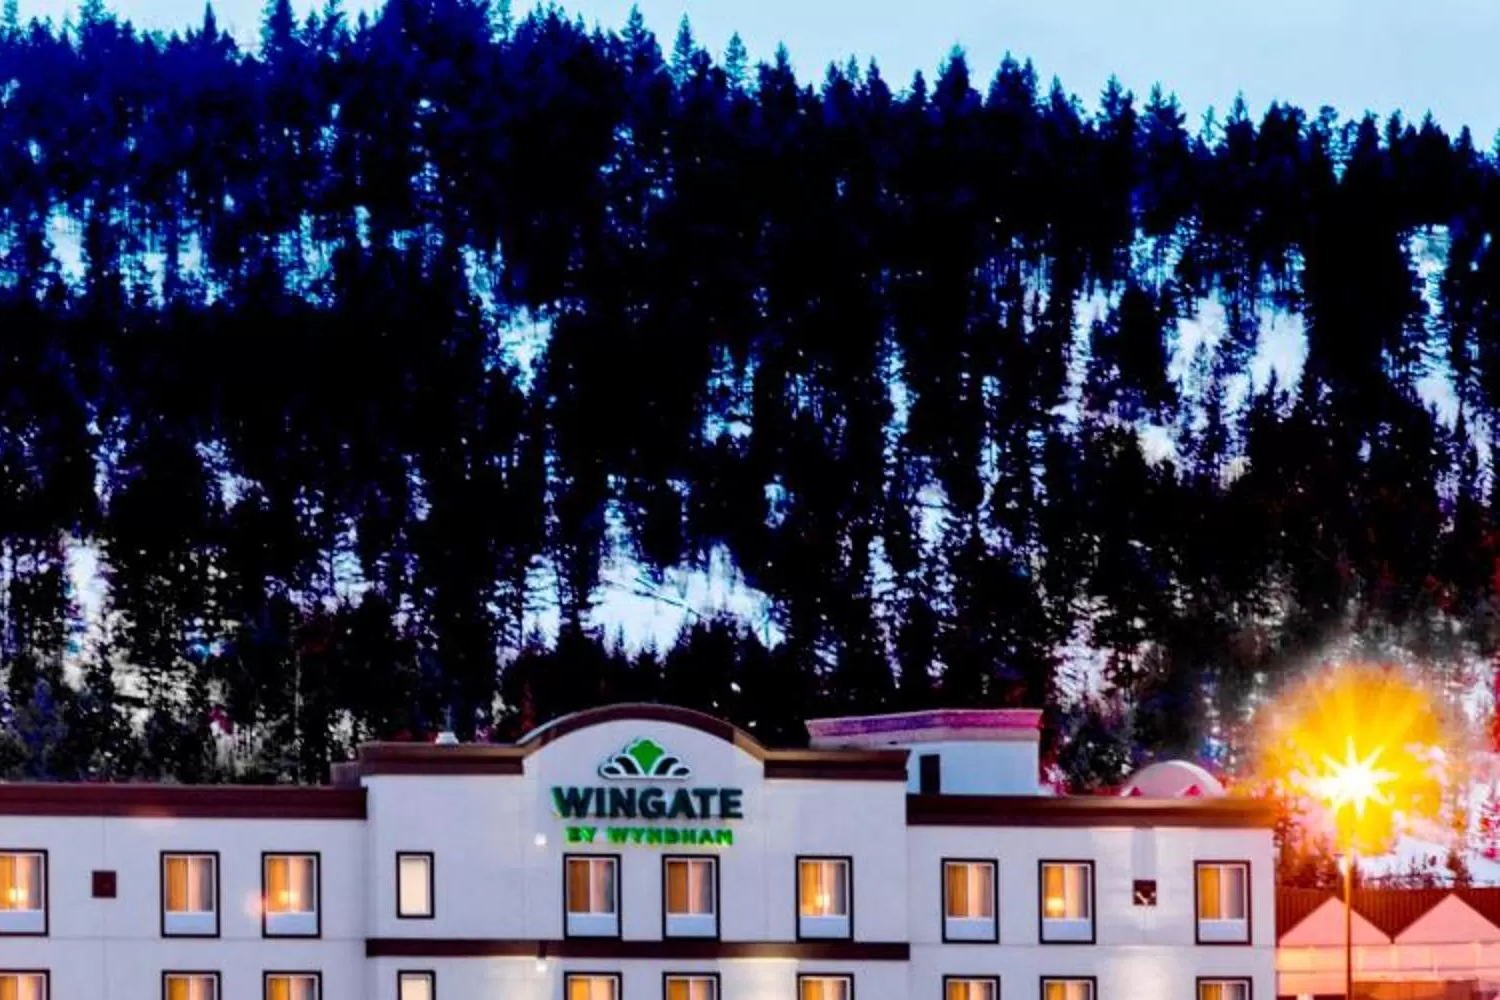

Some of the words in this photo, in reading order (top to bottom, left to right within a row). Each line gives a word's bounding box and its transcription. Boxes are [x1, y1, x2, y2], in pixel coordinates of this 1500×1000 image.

[552, 786, 743, 819] WINGATE
[566, 827, 597, 843] BY
[607, 827, 733, 845] WYNDHAM
